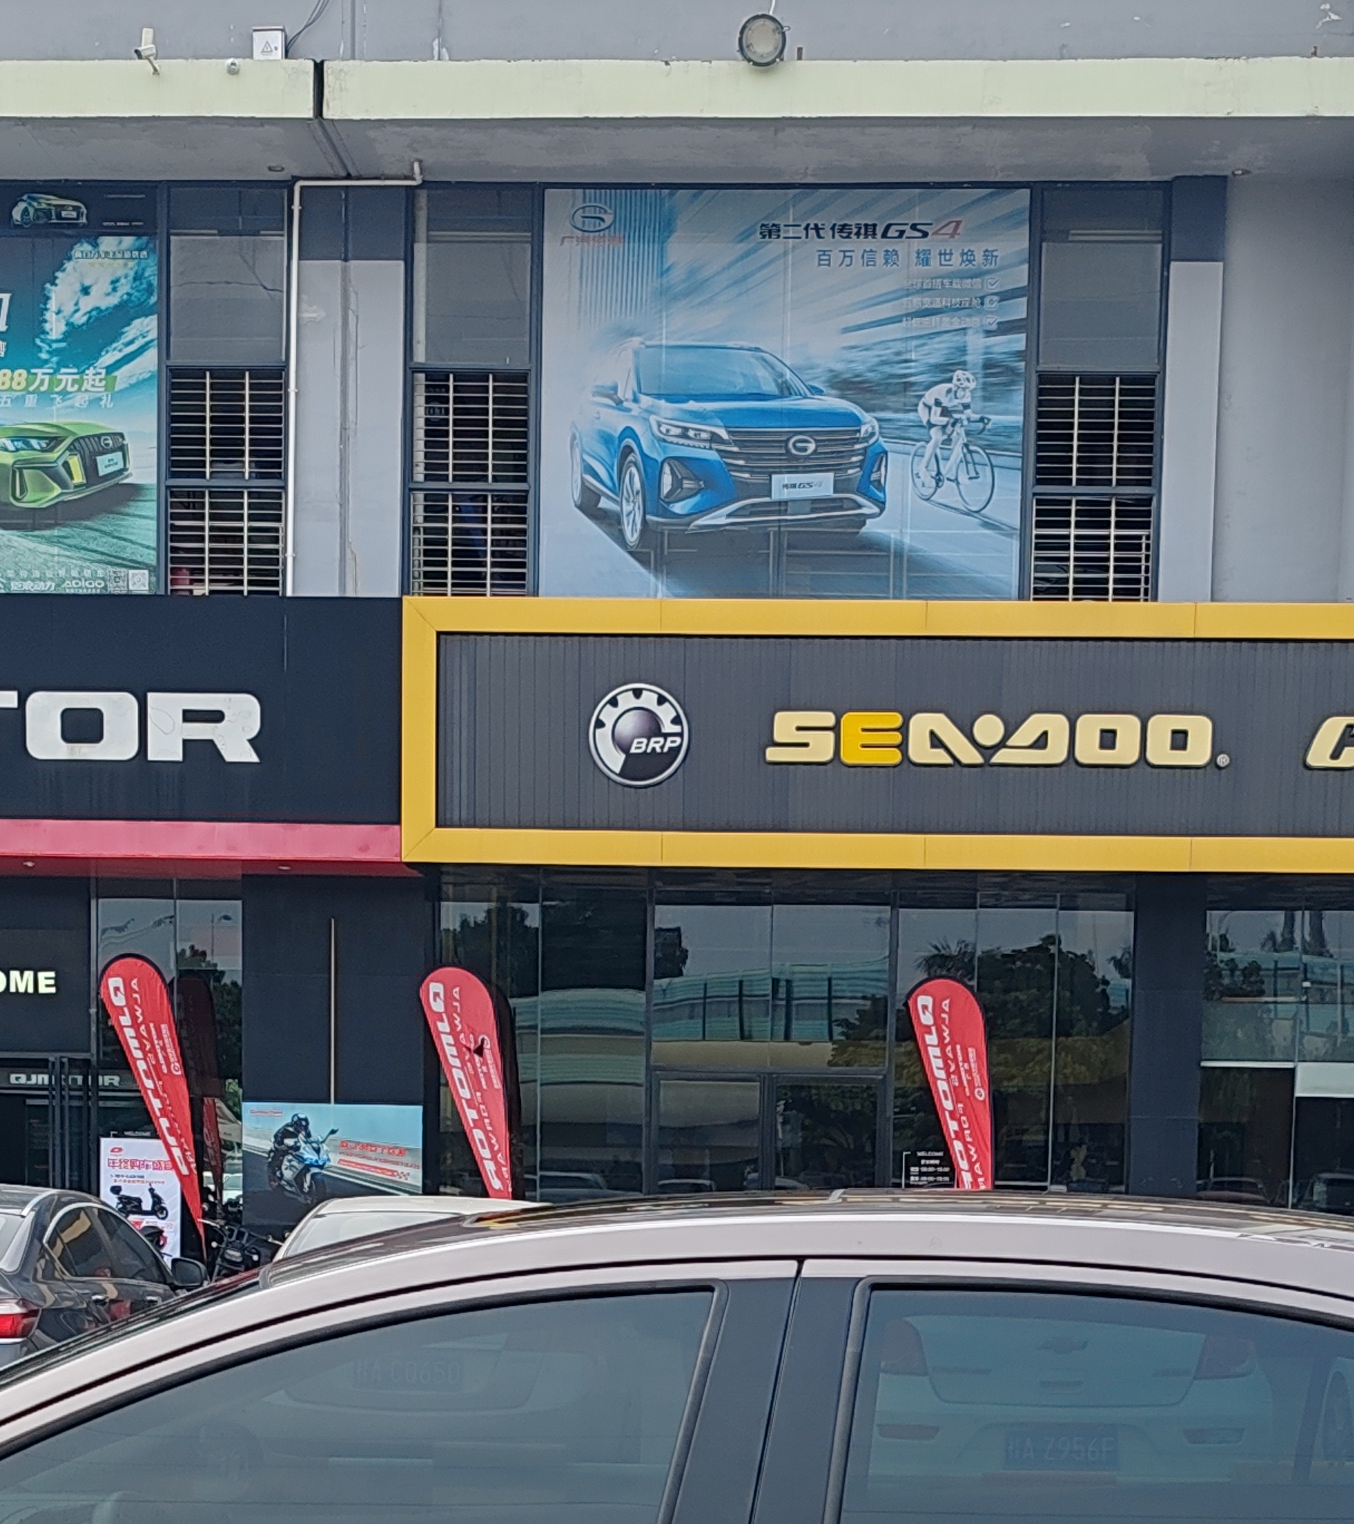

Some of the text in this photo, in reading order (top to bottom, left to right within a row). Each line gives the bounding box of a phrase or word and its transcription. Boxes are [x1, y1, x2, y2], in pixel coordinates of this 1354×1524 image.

[758, 219, 963, 240] 第二代 传祺GS4
[816, 249, 999, 268] 百万信赖 耀世焕新
[628, 734, 682, 756] BRP
